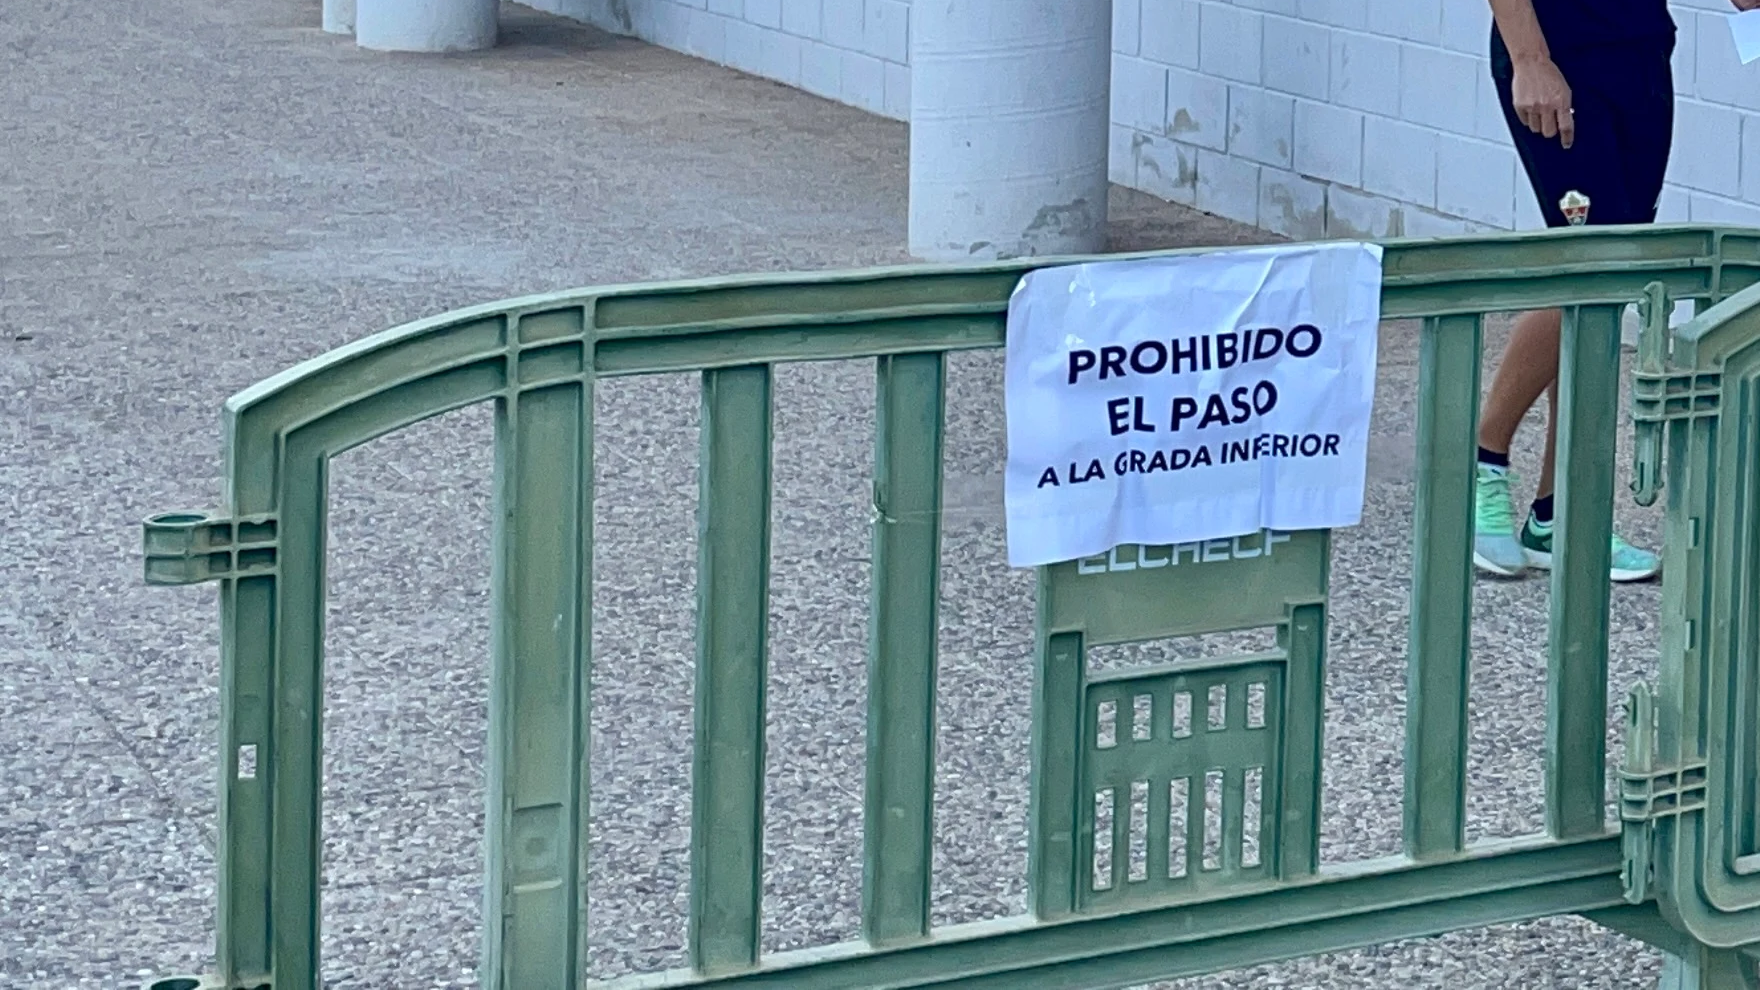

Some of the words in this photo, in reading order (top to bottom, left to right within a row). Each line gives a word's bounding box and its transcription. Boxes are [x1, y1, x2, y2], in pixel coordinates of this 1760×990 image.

[1067, 323, 1323, 385] PROHIBIDO
[1106, 396, 1156, 437] EL
[1169, 379, 1279, 432] PASO
[1036, 466, 1061, 489] A
[1068, 458, 1106, 485] LA
[1113, 444, 1212, 476] GRADA
[1220, 432, 1341, 465] INFERIOR
